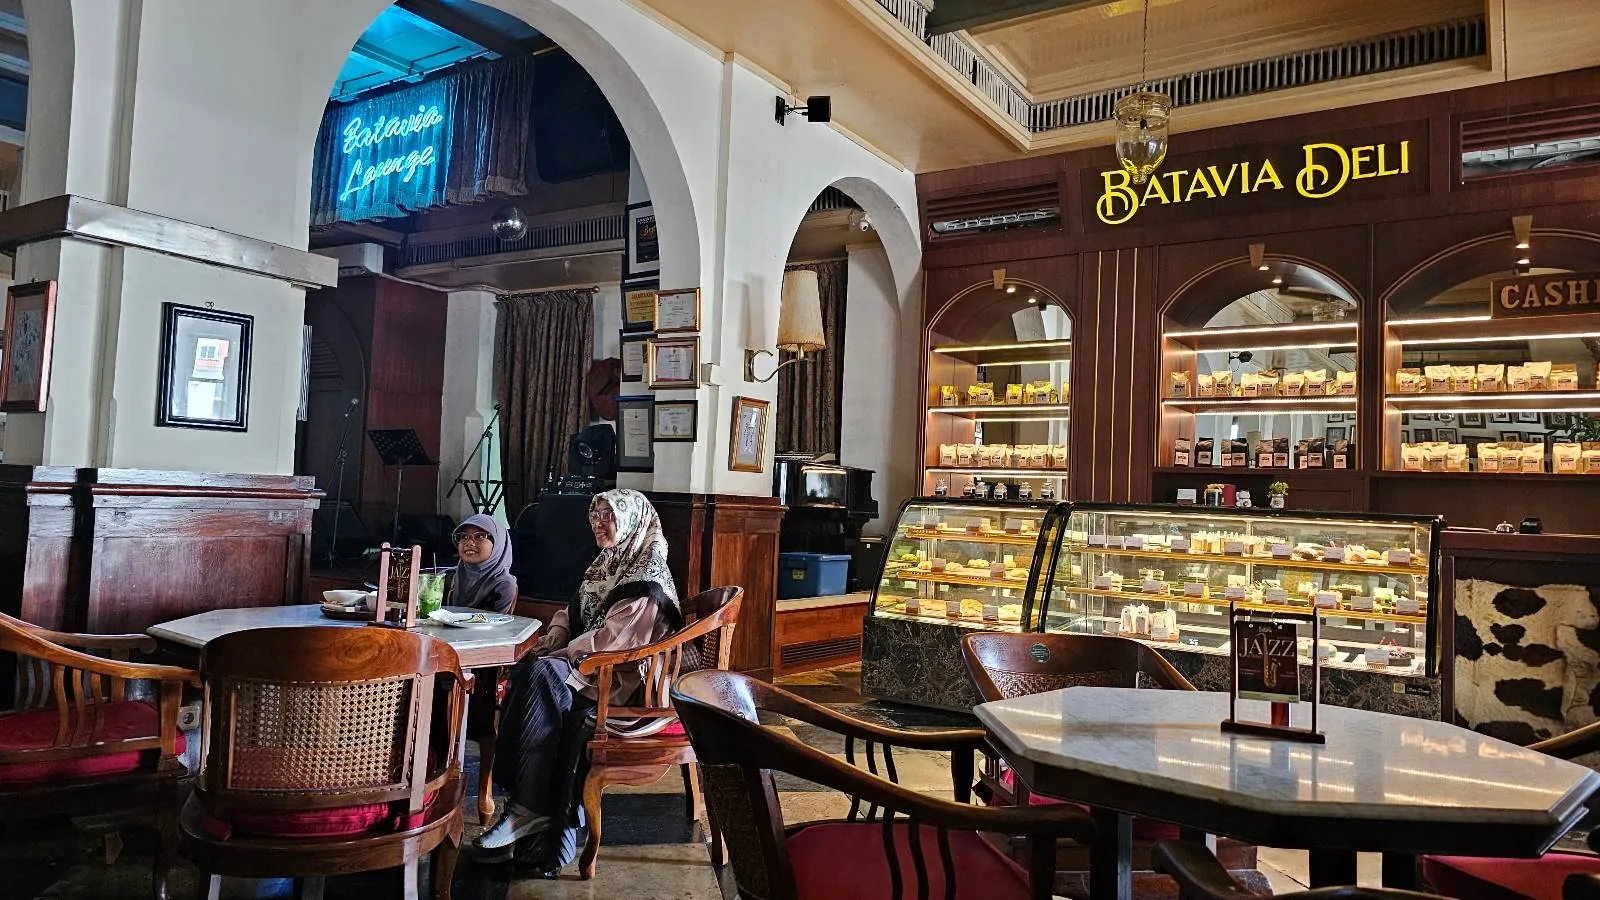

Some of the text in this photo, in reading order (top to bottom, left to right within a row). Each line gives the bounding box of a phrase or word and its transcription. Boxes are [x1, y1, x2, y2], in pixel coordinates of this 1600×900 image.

[343, 105, 443, 153] Batavia
[340, 146, 435, 201] Lounge
[1096, 140, 1409, 225] BATAVIA DELI
[1239, 637, 1295, 658] JAZZ
